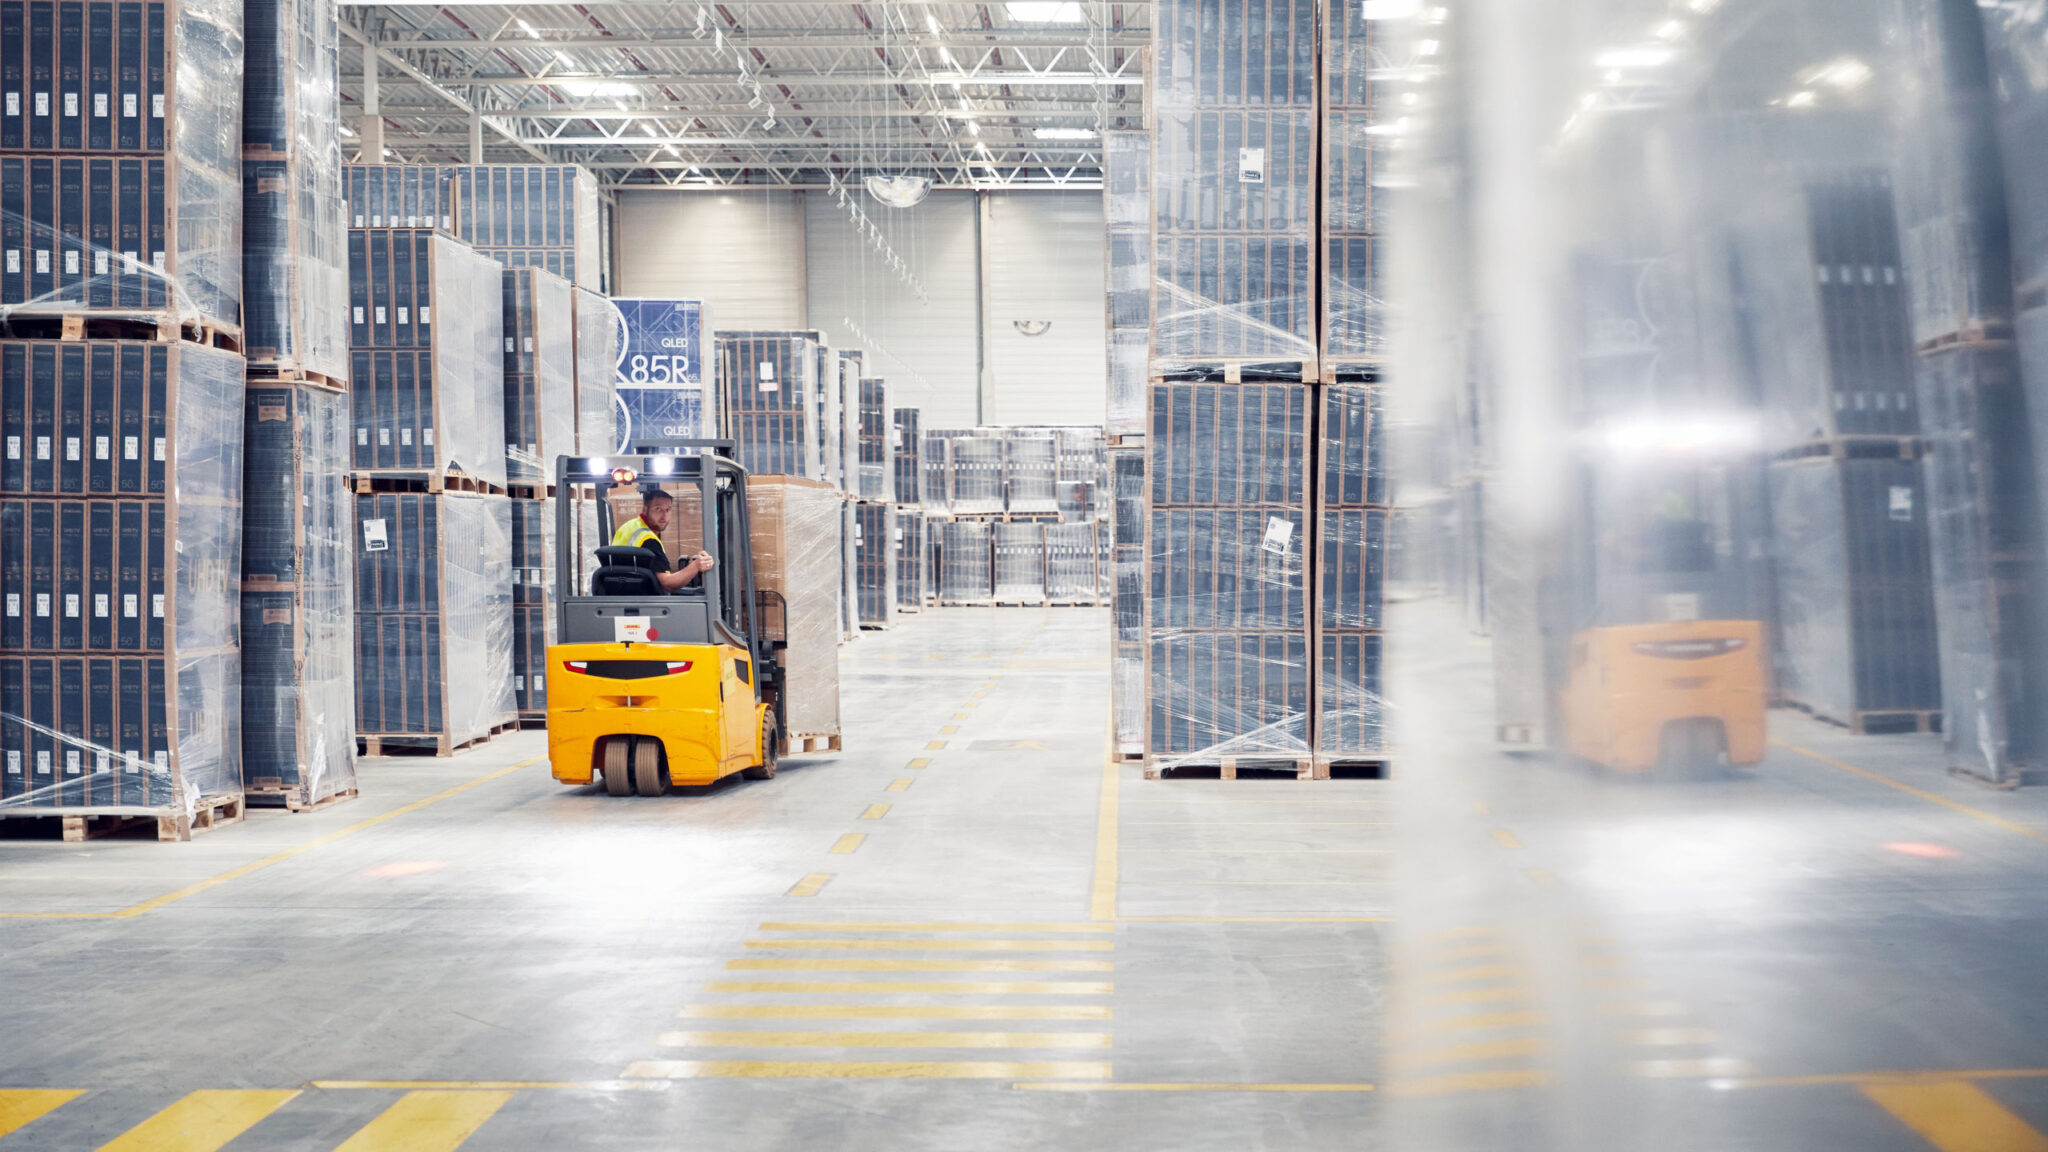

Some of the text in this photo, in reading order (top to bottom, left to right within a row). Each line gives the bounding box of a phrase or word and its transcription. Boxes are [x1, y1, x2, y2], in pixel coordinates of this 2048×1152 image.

[661, 338, 688, 348] QLED
[630, 354, 690, 384] 85R
[664, 426, 690, 436] QLED
